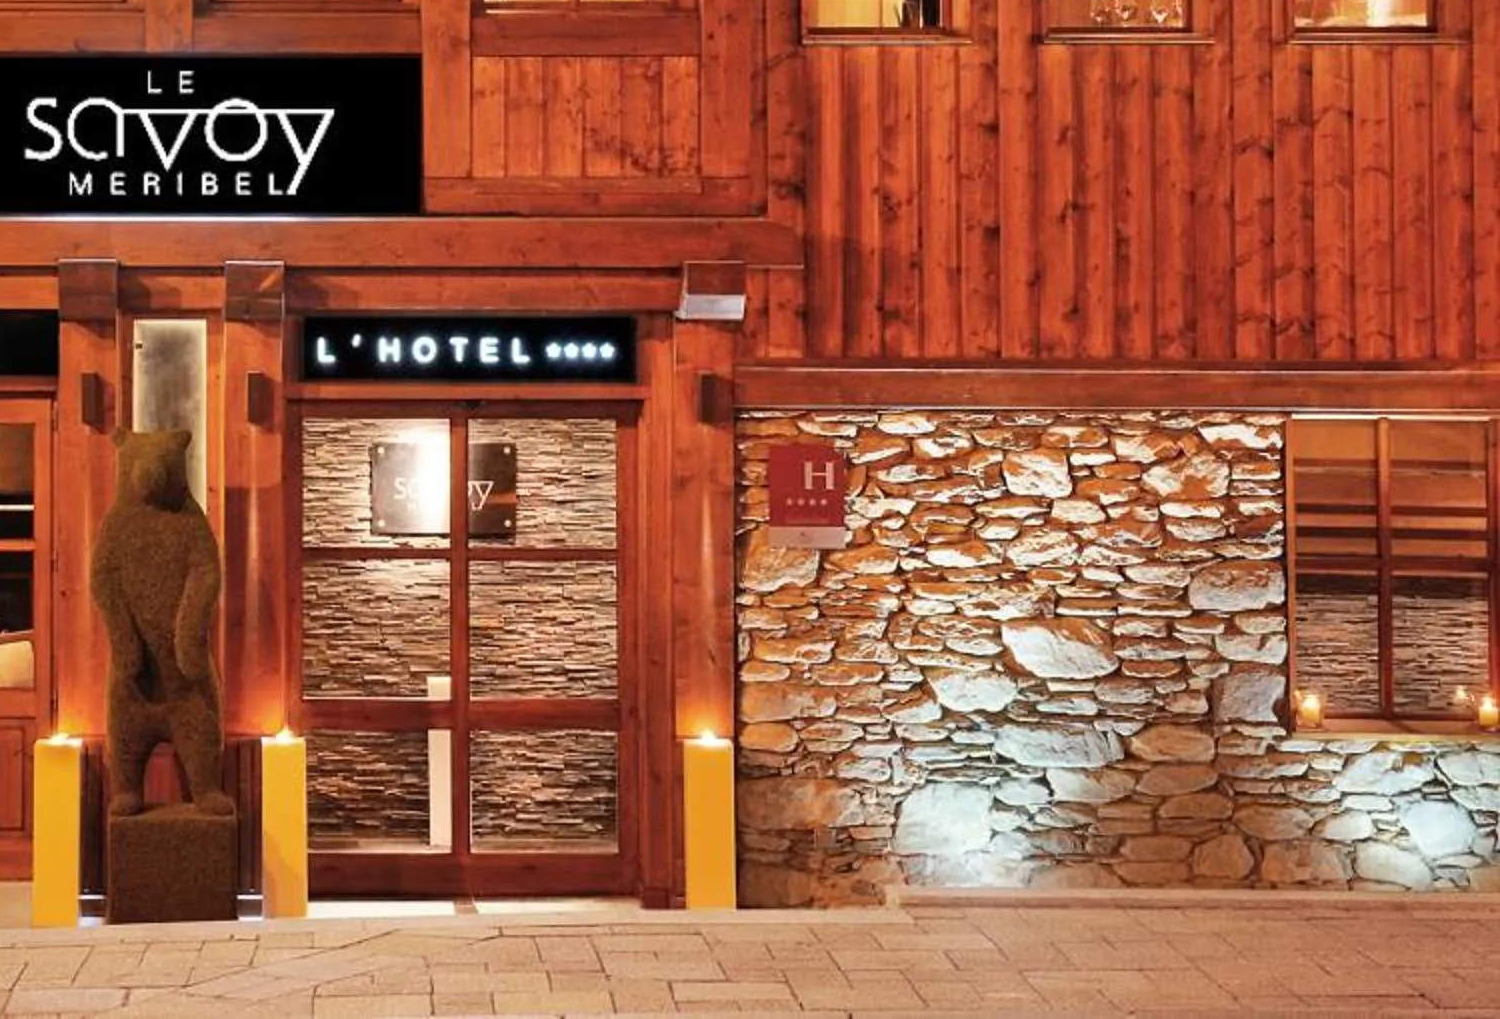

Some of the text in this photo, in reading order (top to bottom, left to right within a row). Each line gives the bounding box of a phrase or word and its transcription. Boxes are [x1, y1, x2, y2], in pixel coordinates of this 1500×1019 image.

[147, 70, 194, 94] LE
[69, 172, 284, 195] MERIBEL
[316, 334, 531, 364] L'HOTEL
[804, 461, 834, 490] H
